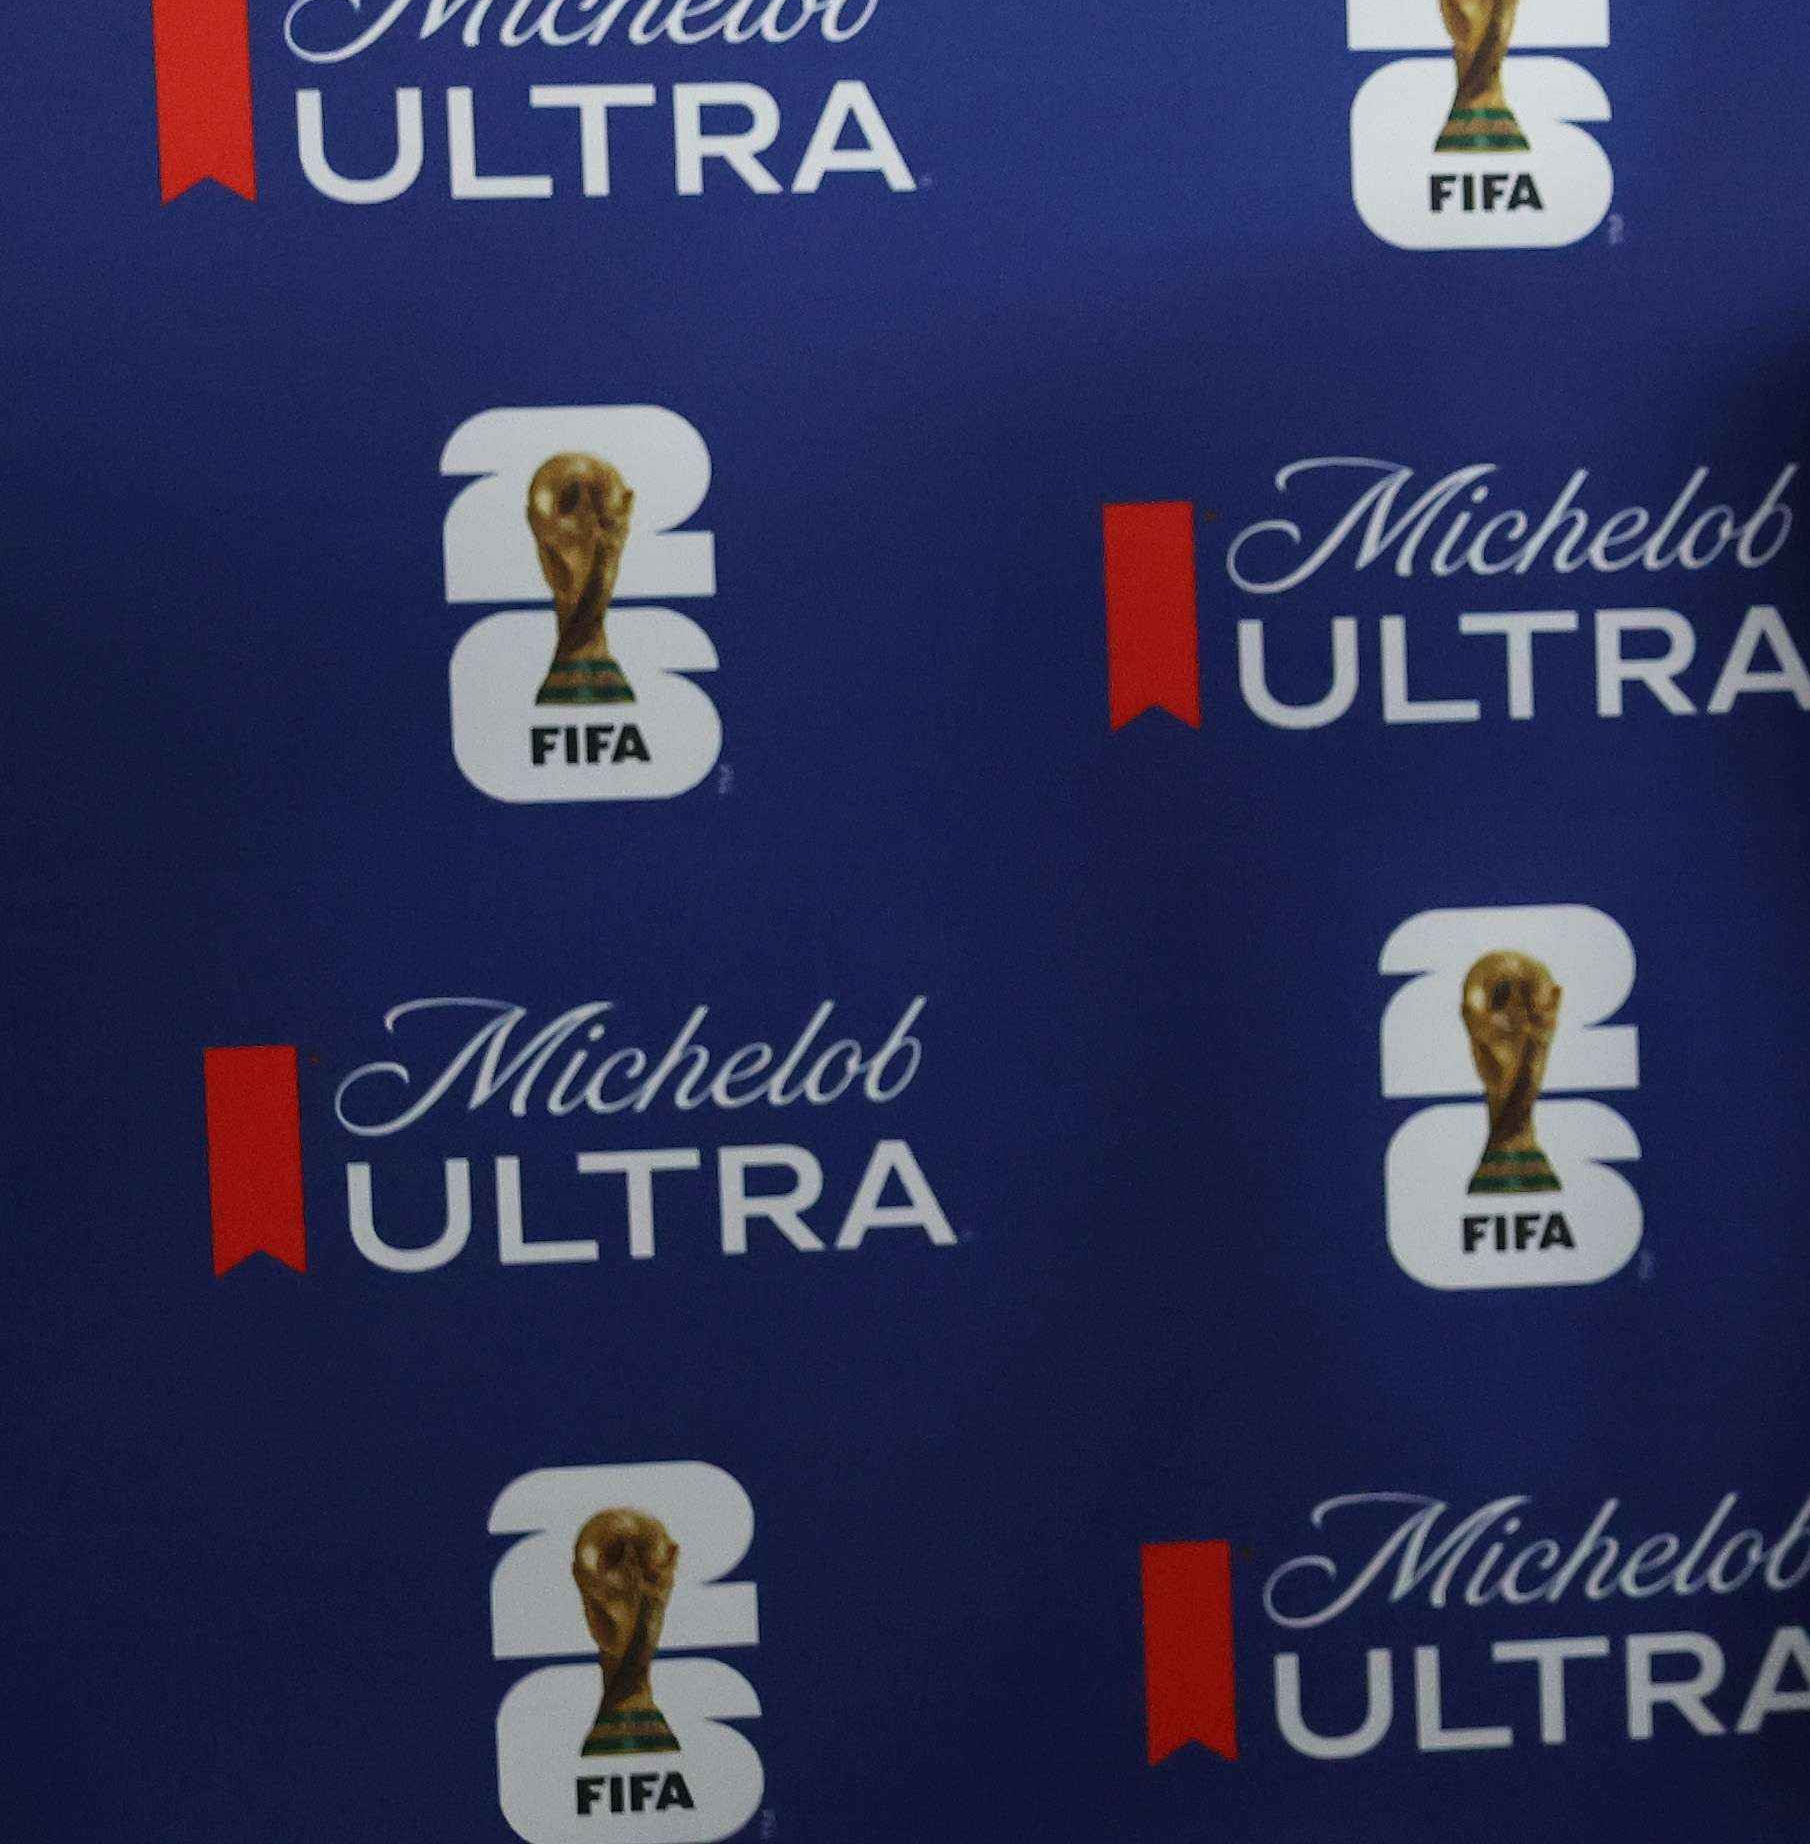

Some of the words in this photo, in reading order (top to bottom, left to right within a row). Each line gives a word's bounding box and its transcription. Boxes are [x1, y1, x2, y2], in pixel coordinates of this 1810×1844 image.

[296, 80, 916, 204] ULTRA
[1428, 172, 1545, 214] FIFA
[1227, 457, 1795, 593] Michelob
[529, 722, 652, 768] FIFA
[335, 996, 926, 1136] Michelob
[347, 1139, 957, 1272] ULTRA
[1461, 1210, 1577, 1255] FIFA
[574, 1770, 696, 1817] FIFA
